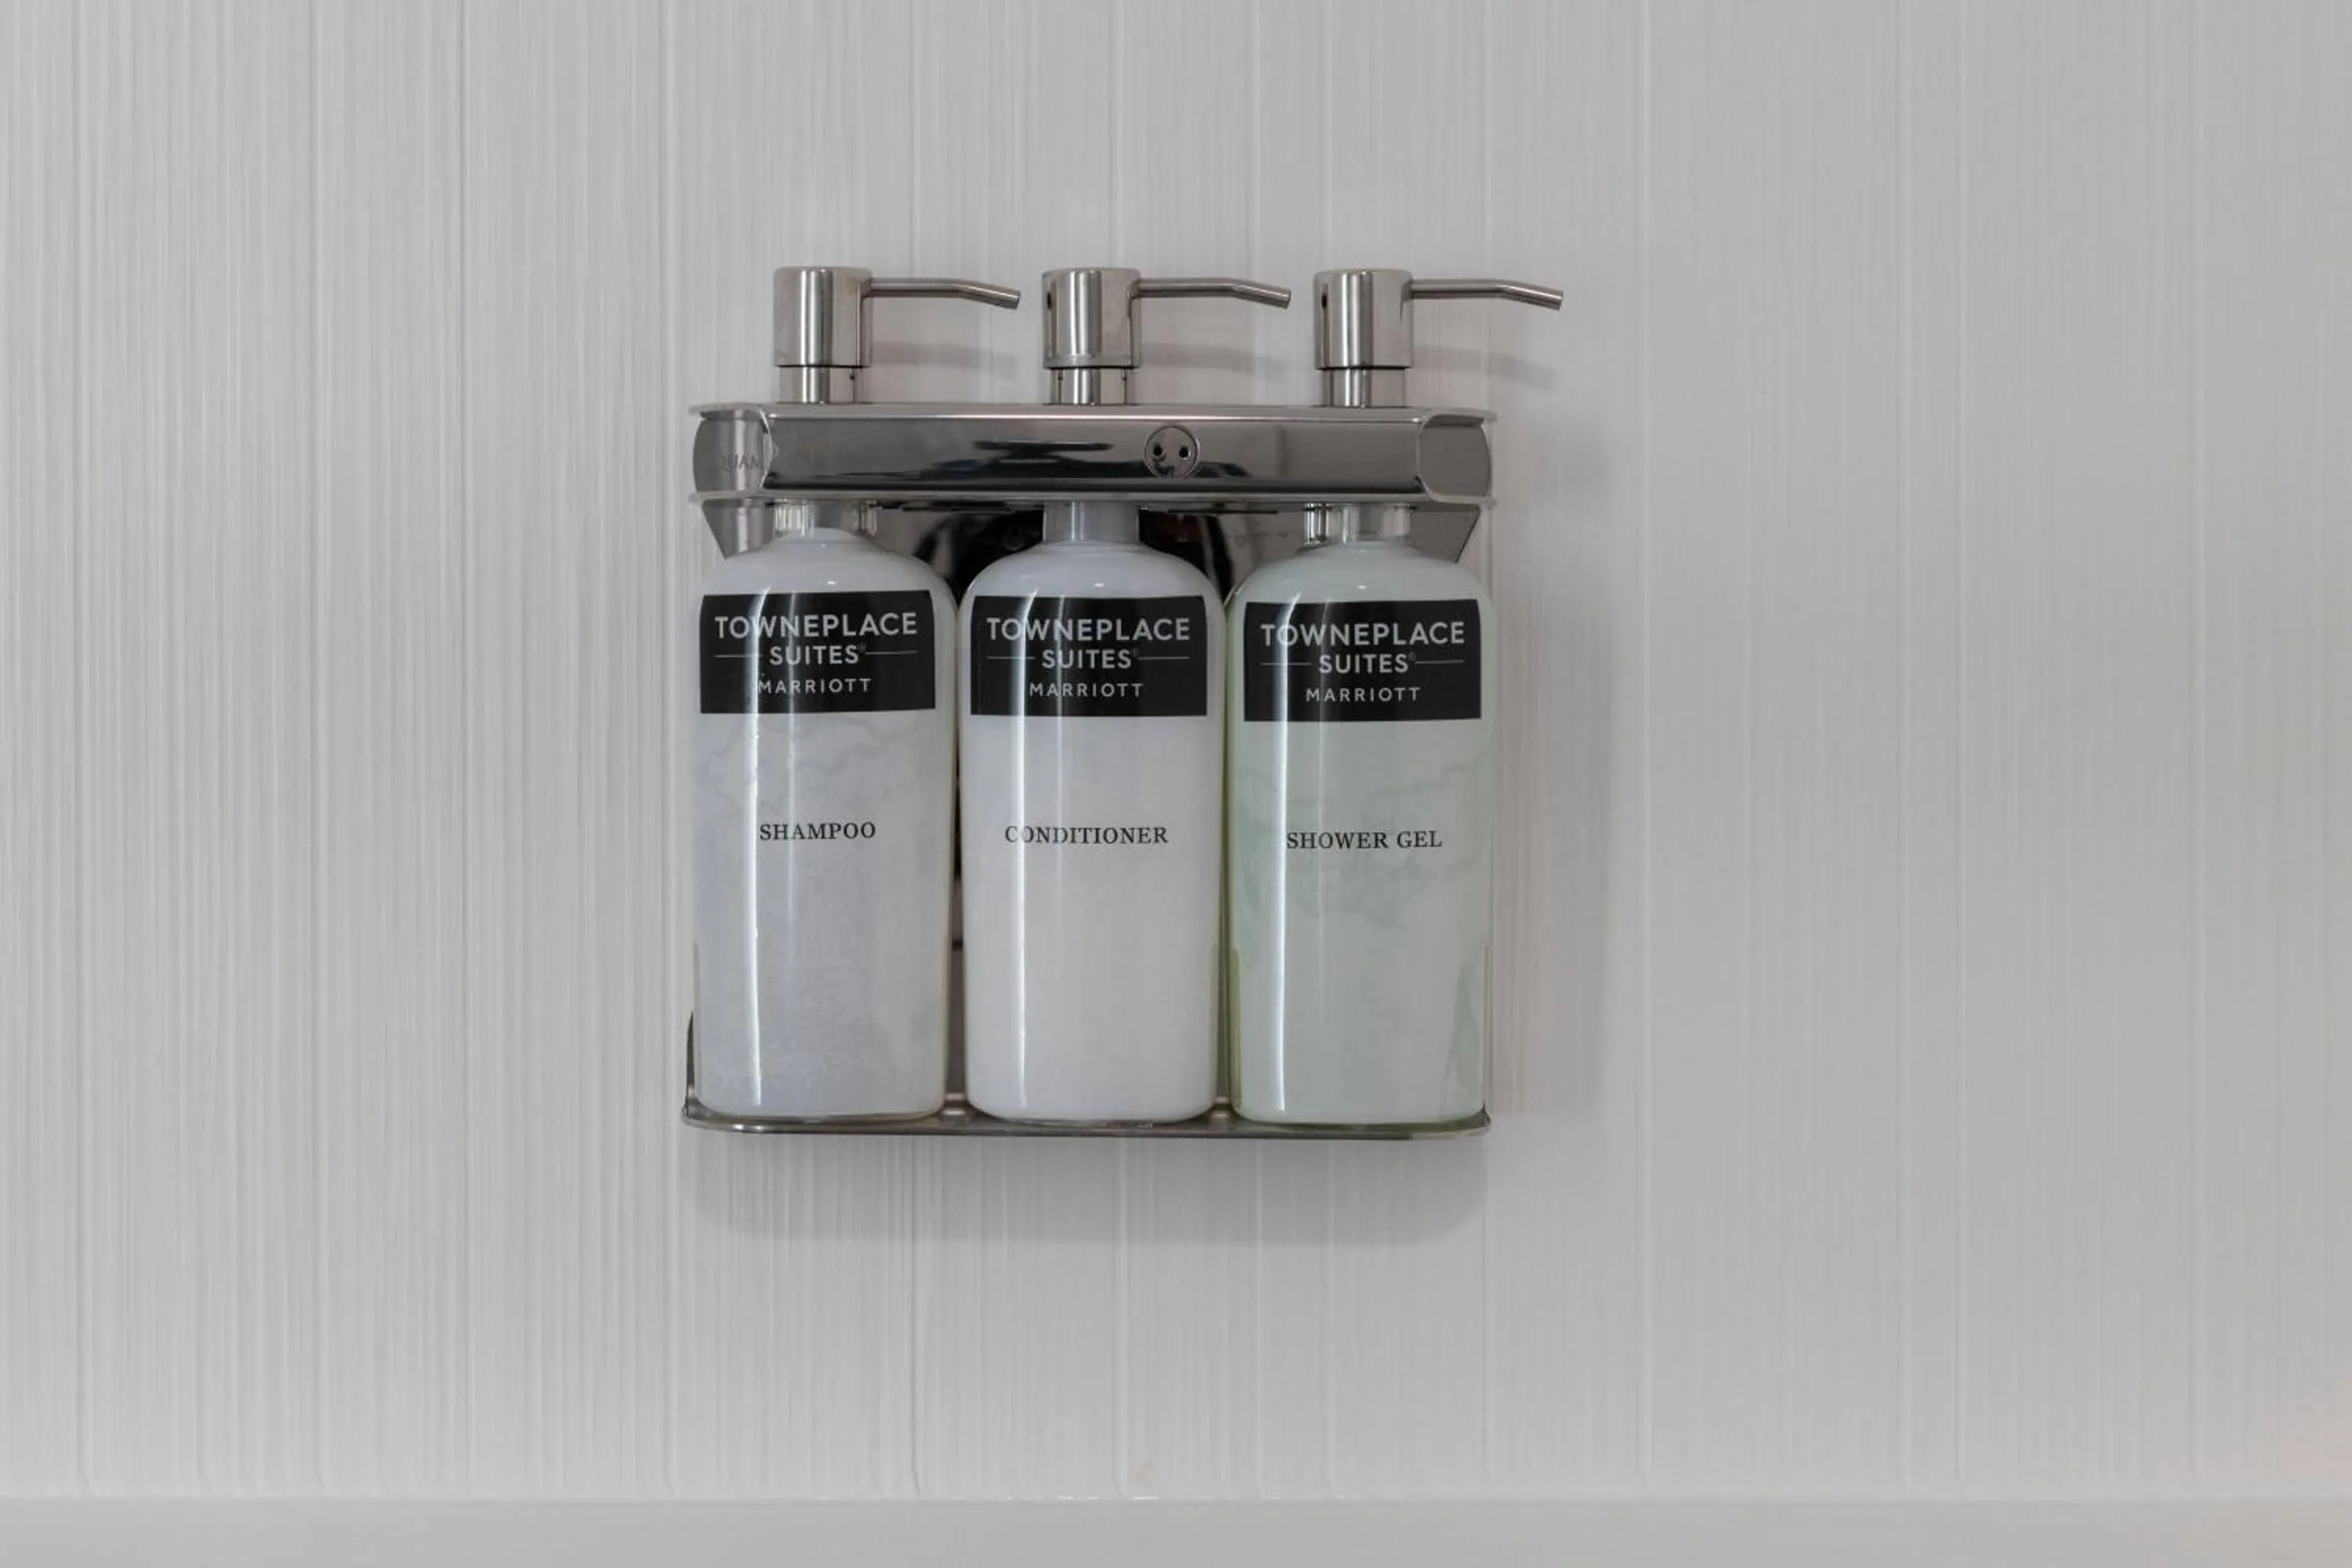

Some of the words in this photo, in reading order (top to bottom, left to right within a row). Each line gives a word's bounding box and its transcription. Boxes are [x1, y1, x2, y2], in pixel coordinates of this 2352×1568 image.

[714, 612, 917, 639] TOWNEPLACE
[986, 617, 1190, 641] TOWNEPLACE
[1260, 622, 1465, 647] TOWNEPLACE
[757, 678, 872, 694] MARRIOTT
[1029, 683, 1143, 697] MARRIOTT
[1305, 687, 1421, 702] MARRIOTT
[759, 822, 876, 840] SHAMPOO
[1004, 826, 1169, 844] CONDITIONER
[1286, 832, 1389, 849] SHOWER
[1396, 830, 1443, 848] GEL
